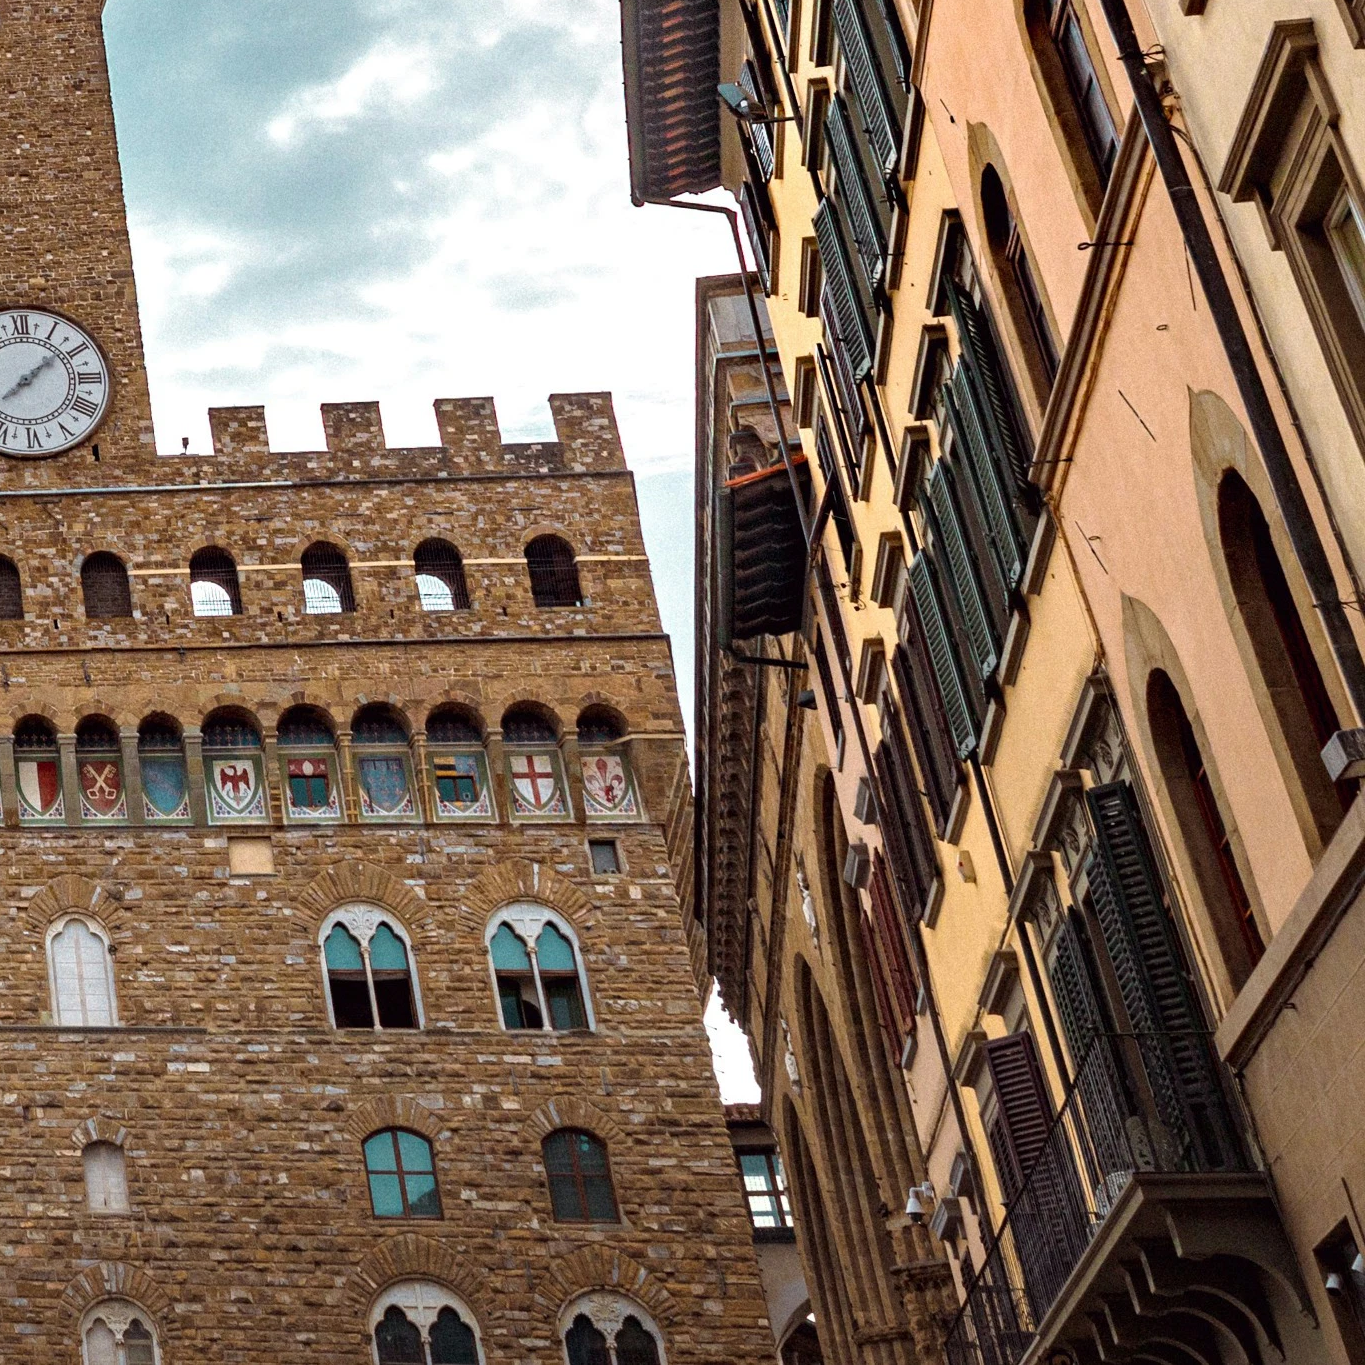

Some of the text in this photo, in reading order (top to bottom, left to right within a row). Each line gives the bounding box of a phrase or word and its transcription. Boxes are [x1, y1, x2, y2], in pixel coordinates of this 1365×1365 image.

[10, 314, 30, 335] XII
[45, 321, 60, 341] I
[66, 341, 89, 360] II
[77, 371, 102, 386] III
[70, 396, 99, 419] IIII
[25, 427, 43, 449] VI
[57, 421, 75, 442] V
